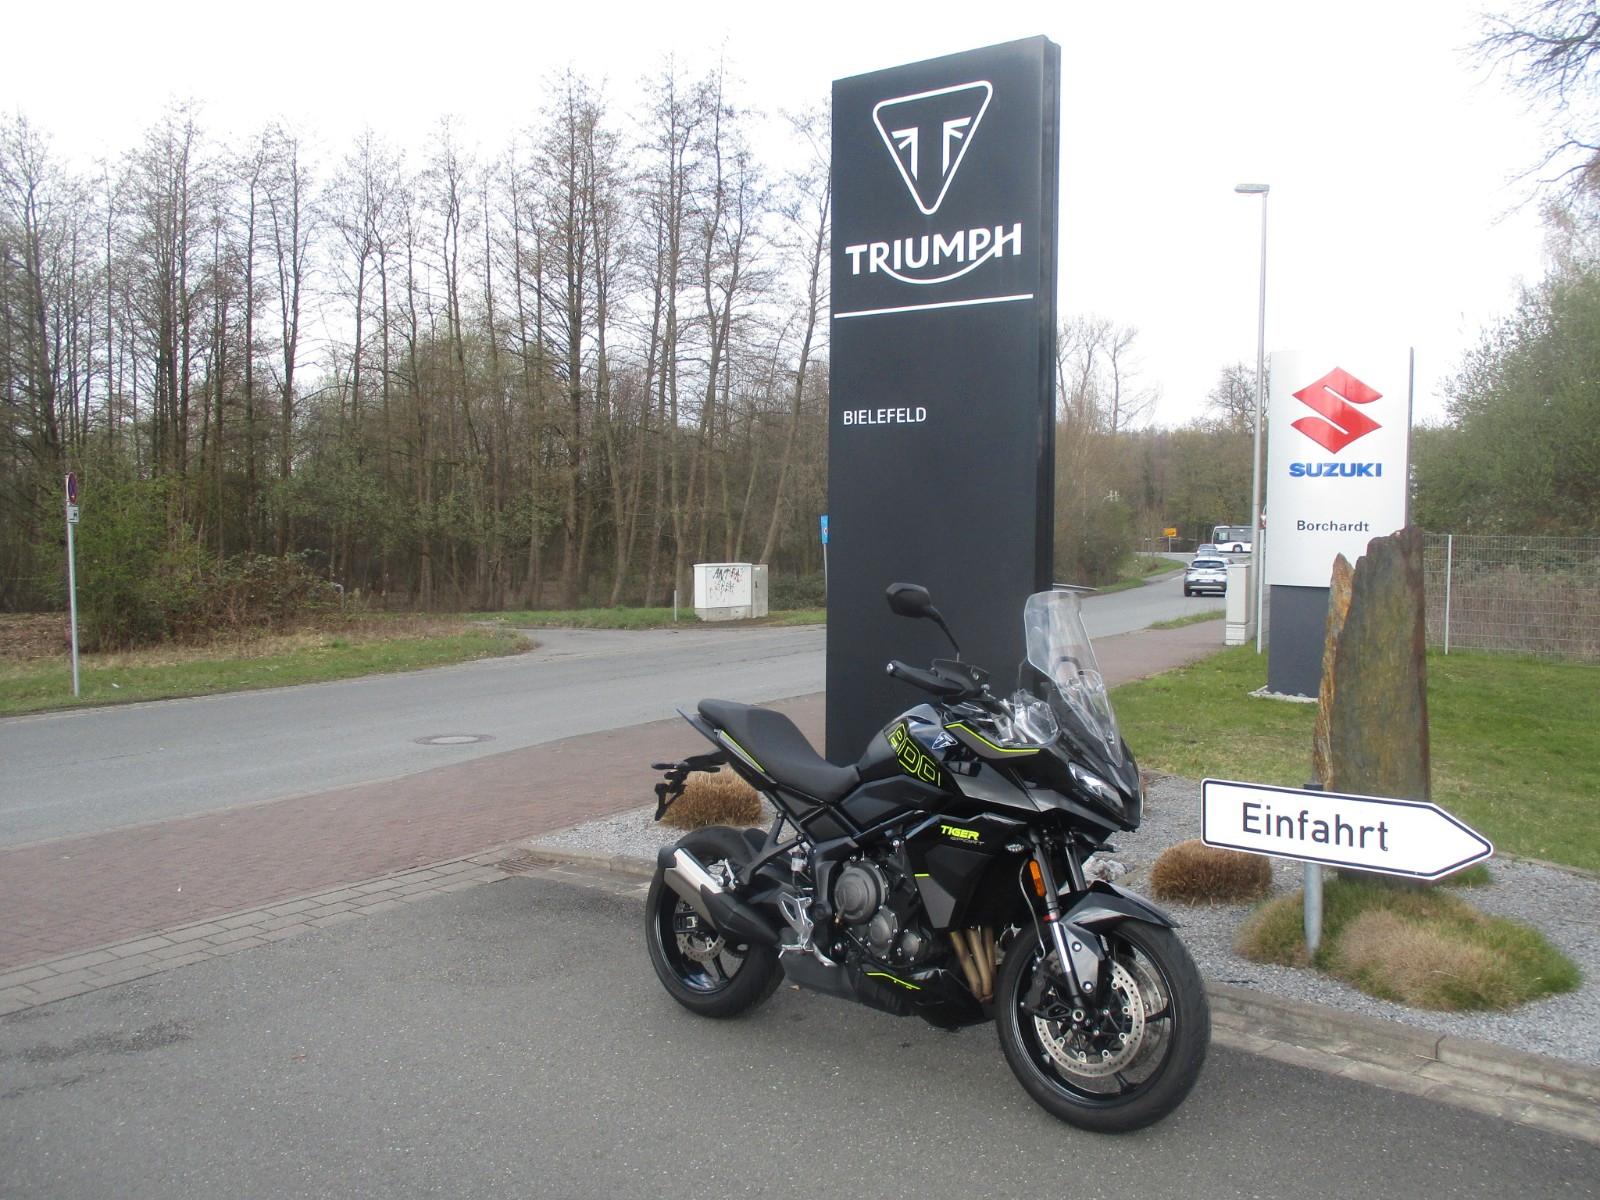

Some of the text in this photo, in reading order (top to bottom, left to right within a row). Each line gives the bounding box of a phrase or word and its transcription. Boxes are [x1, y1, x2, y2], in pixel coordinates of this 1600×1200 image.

[845, 222, 1022, 285] TRIUMPH
[843, 407, 927, 425] BIELEFELD
[1289, 462, 1382, 478] SUZUKI
[1296, 520, 1369, 532] Borchardt
[940, 825, 980, 841] TIGER
[1242, 802, 1389, 851] Einfahrt
